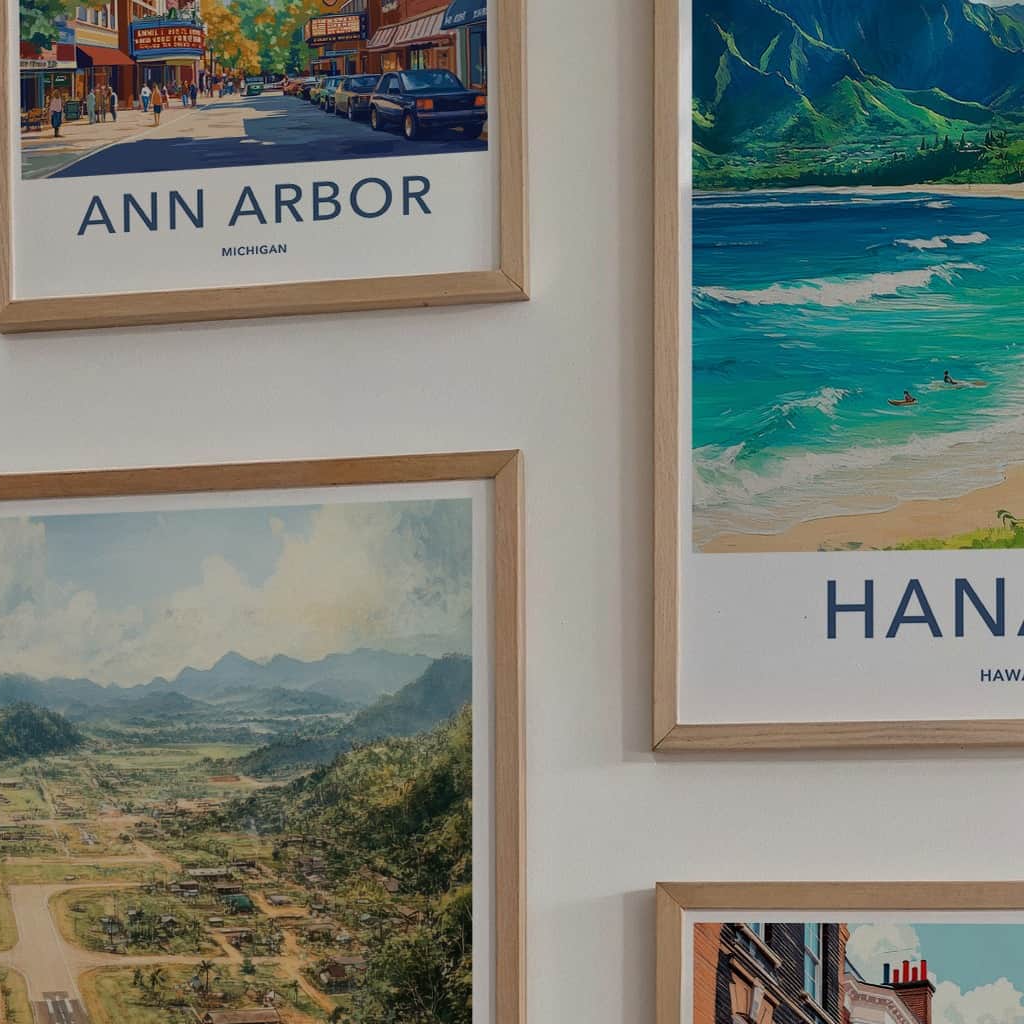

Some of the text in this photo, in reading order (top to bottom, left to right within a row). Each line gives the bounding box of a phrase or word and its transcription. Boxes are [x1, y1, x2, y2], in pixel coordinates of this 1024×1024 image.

[77, 175, 432, 236] ANN ARBOR
[221, 243, 288, 257] MICHIGAN
[826, 577, 1024, 639] HAN
[980, 668, 1024, 682] HAW
